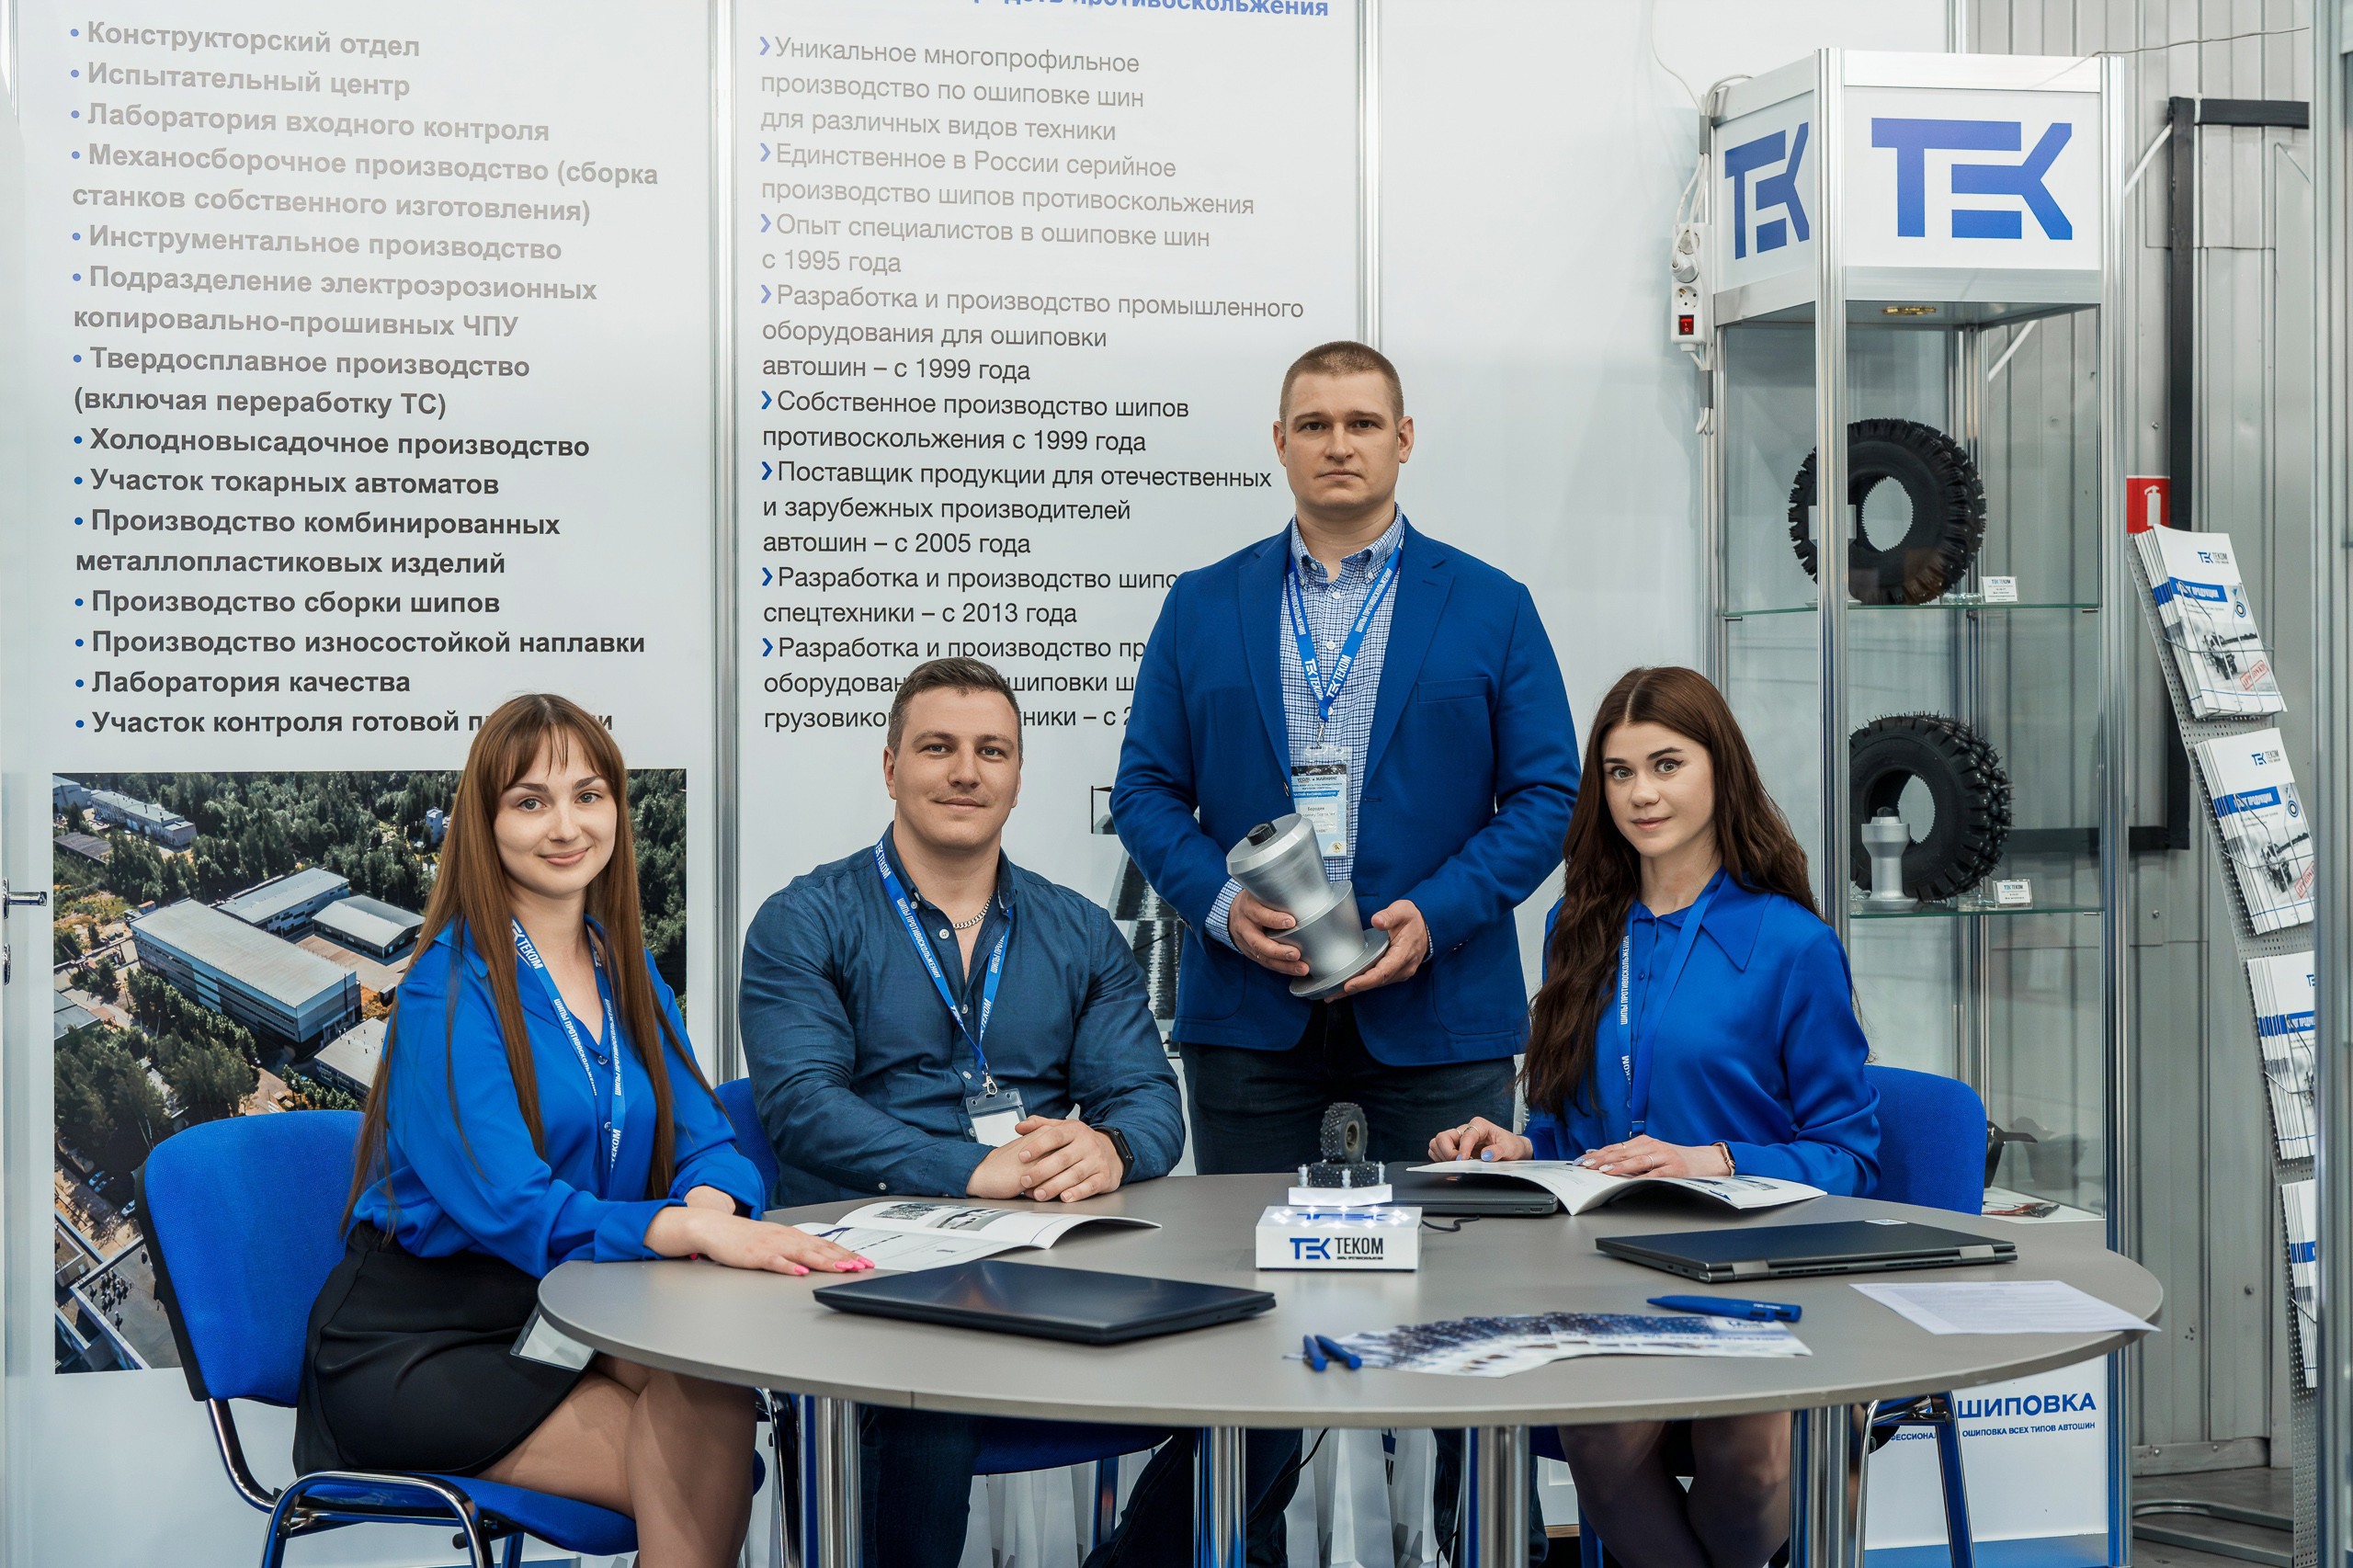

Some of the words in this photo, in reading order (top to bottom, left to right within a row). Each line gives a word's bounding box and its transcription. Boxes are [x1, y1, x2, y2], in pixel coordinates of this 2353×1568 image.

[1073, 0, 1328, 16] воскольжения
[88, 21, 330, 54] Конструкторский
[340, 38, 419, 58] отдел
[775, 37, 916, 62] Уникальное
[925, 49, 1139, 74] многопрофильное
[89, 62, 320, 92] Испытательный
[331, 77, 409, 100] центр
[762, 76, 929, 100] производство
[938, 85, 965, 99] по
[973, 85, 1089, 105] ошиповке
[1098, 91, 1142, 107] шин
[88, 103, 276, 134] Лаборатория
[287, 116, 414, 137] входного
[425, 121, 549, 143] контроля
[761, 112, 802, 131] для
[813, 114, 940, 134] различных
[949, 119, 1017, 140] видов
[1025, 123, 1115, 140] техники
[89, 143, 346, 175] Механосборочное
[356, 158, 548, 181] производство
[558, 160, 657, 188] (сборка
[778, 143, 946, 168] Единственное
[954, 154, 966, 169] в
[975, 151, 1058, 173] России
[1067, 155, 1176, 179] серийное
[73, 189, 185, 208] станков
[195, 188, 386, 214] собственного
[397, 199, 589, 226] изготовления)
[763, 183, 930, 205] производство
[939, 189, 1014, 206] шипов
[1023, 192, 1254, 214] противоскольжения
[90, 225, 359, 254] Инструментальное
[369, 239, 562, 261] производство
[777, 213, 841, 234] Опыт
[848, 222, 1013, 241] специалистов
[1022, 227, 1033, 241] в
[1041, 227, 1156, 244] ошиповке
[1165, 232, 1209, 246] шин
[763, 254, 775, 268] с
[785, 250, 840, 270] 1995
[849, 256, 901, 276] года
[91, 266, 312, 293] Подразделение
[321, 277, 597, 301] электроэрозионных
[779, 284, 917, 311] Разработка
[926, 293, 938, 308] и
[948, 294, 1110, 315] производство
[1119, 299, 1303, 318] промышленного
[74, 311, 454, 337] копировально-прошивных
[463, 315, 518, 336] ЧПУ
[763, 320, 933, 346] оборудования
[941, 329, 982, 347] для
[991, 330, 1106, 347] ошиповки
[90, 347, 326, 374] Твердосплавное
[336, 358, 529, 379] производство
[763, 359, 865, 377] автошин
[894, 362, 907, 377] с
[916, 358, 971, 379] 1999
[980, 364, 1030, 383] года
[74, 387, 206, 414] (включая
[217, 392, 392, 419] переработку
[401, 393, 446, 420] ТС)
[778, 390, 936, 413] Собственное
[944, 399, 1108, 419] производство
[1116, 402, 1188, 417] шипов
[90, 427, 389, 456] Холодновысадочное
[399, 438, 589, 459] производство
[764, 430, 1004, 450] противоскольжения
[1013, 434, 1025, 449] с
[1034, 430, 1087, 450] 1999
[1097, 436, 1146, 455] года
[90, 469, 203, 491] Участок
[211, 475, 347, 496] токарных
[355, 477, 499, 494] автоматов
[779, 460, 913, 485] Поставщик
[921, 468, 1044, 488] продукции
[1052, 470, 1093, 488] для
[1101, 471, 1272, 487] отечественных
[764, 501, 776, 516] и
[785, 497, 933, 522] зарубежных
[941, 500, 1130, 523] производителей
[93, 509, 295, 536] Производство
[305, 511, 561, 539] комбинированных
[764, 536, 866, 551] автошин
[895, 537, 907, 552] с
[915, 533, 971, 552] 2005
[980, 538, 1030, 557] года
[76, 555, 382, 573] металлопластиковых
[392, 552, 505, 576] изделий
[779, 566, 918, 592] Разработка
[926, 573, 938, 587] и
[949, 573, 1110, 593] производство
[1119, 574, 1177, 588] шипо
[93, 590, 295, 617] Производство
[304, 591, 401, 618] сборки
[411, 597, 500, 613] шипов
[764, 607, 914, 626] спецтехники
[942, 608, 955, 622] с
[962, 603, 1017, 622] 2013
[1027, 608, 1077, 627] года
[93, 631, 295, 657] Производство
[305, 631, 509, 653] износостойкой
[520, 637, 644, 653] наплавки
[779, 637, 919, 662] Разработка
[927, 642, 939, 657] и
[949, 642, 1111, 661] производство
[1336, 654, 1352, 682] ТЕКОМ
[92, 671, 279, 698] Лаборатория
[290, 676, 410, 692] качества
[764, 673, 906, 698] оборудован
[1007, 676, 1107, 691] шиповки
[92, 711, 205, 733] Участок
[214, 716, 342, 737] контроля
[353, 710, 459, 732] готовой
[765, 712, 890, 733] грузовико
[1104, 711, 1116, 726] с
[877, 855, 892, 880] ТЕКОМ
[896, 897, 912, 917] ШИПЫ
[905, 915, 941, 978] ПРОТИВОСКОЛЬЖЕНИЯ
[517, 937, 544, 970] ТЕКОМ
[553, 998, 567, 1022] ШИПЫ
[1620, 1005, 1629, 1026] ШИПЫ
[1290, 1238, 1331, 1260] ТЕК
[1335, 1237, 1383, 1255] ТЕКОМ
[1958, 1392, 2097, 1419] ШИПОВКА
[1961, 1428, 2007, 1437] ОШИПОВКА
[2008, 1426, 2029, 1435] ВСЕХ
[2030, 1425, 2056, 1433] ТИПОВ
[2058, 1422, 2096, 1431] АВТОШИН
